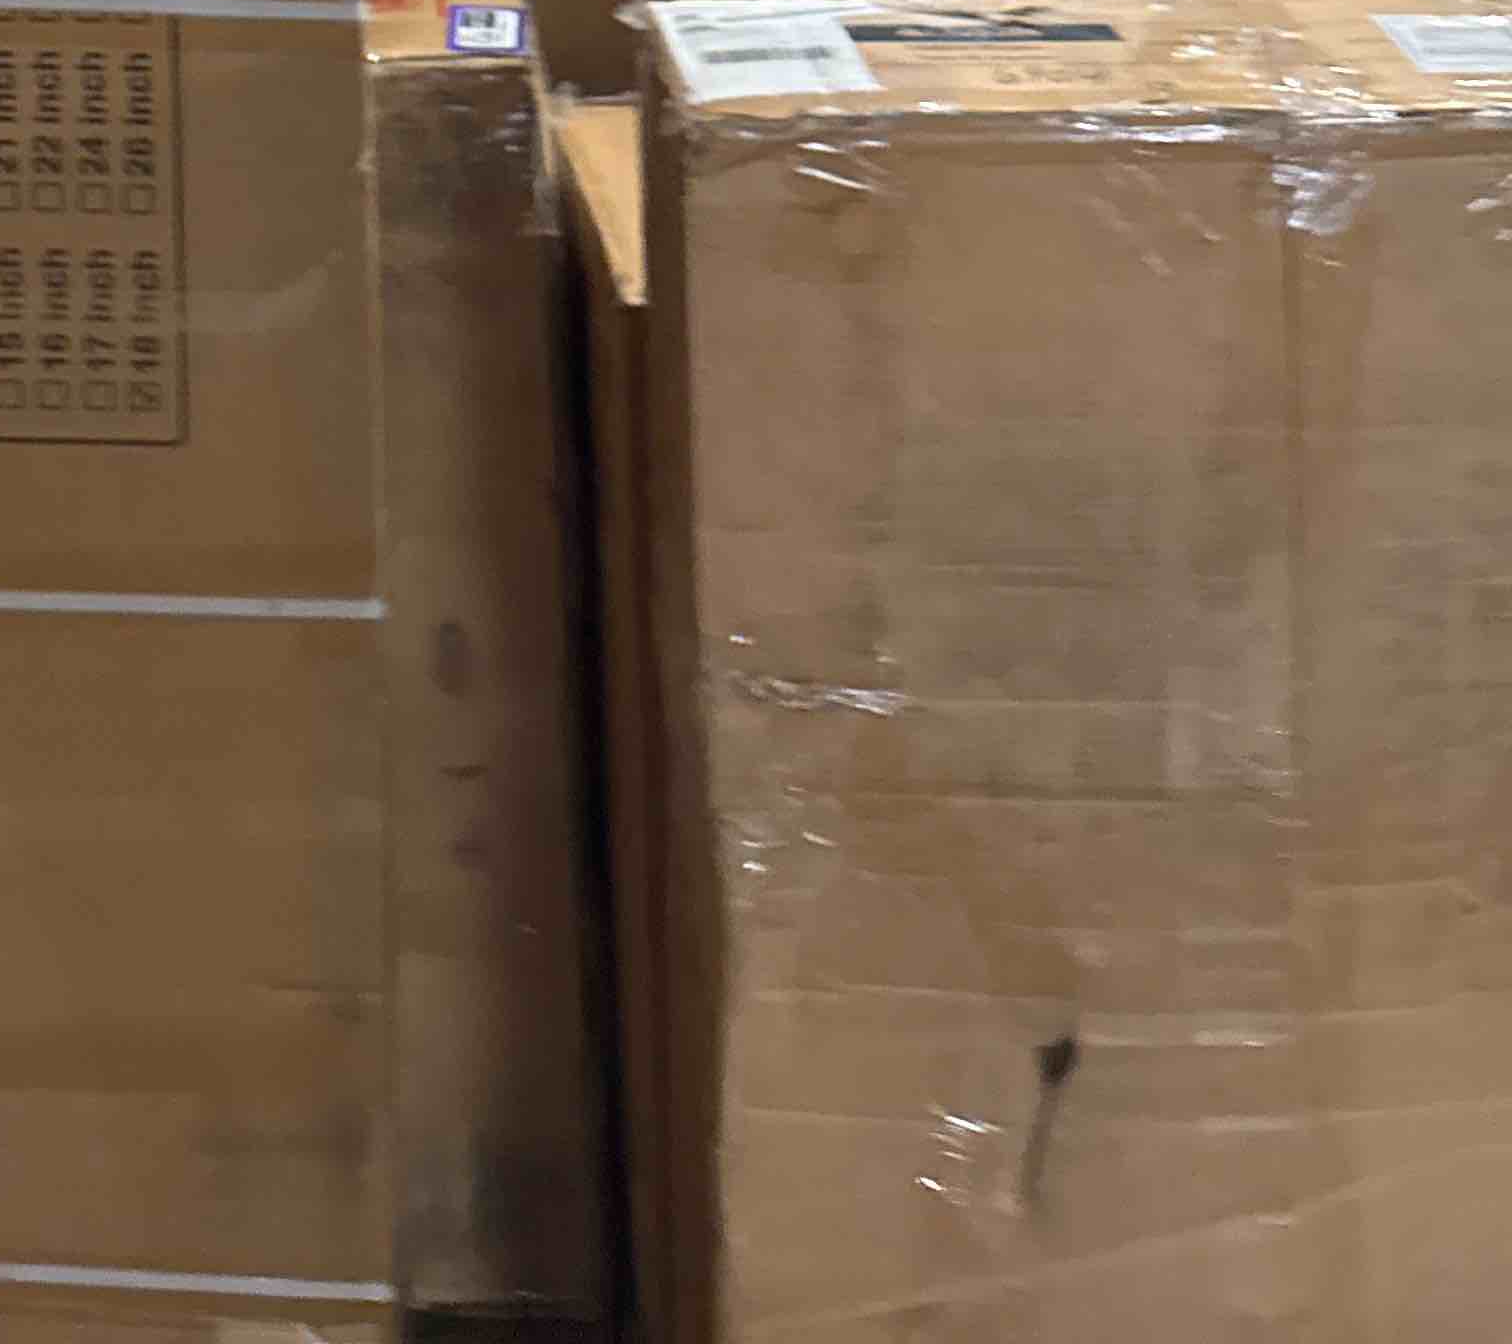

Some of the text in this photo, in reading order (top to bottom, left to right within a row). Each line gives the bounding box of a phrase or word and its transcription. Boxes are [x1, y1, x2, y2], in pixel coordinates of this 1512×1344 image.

[32, 50, 65, 175] 22 inch
[76, 52, 111, 176] 24 inch
[122, 52, 154, 126] inch
[37, 247, 73, 321] inch
[82, 248, 116, 372] 17 inch
[128, 249, 162, 324] inch
